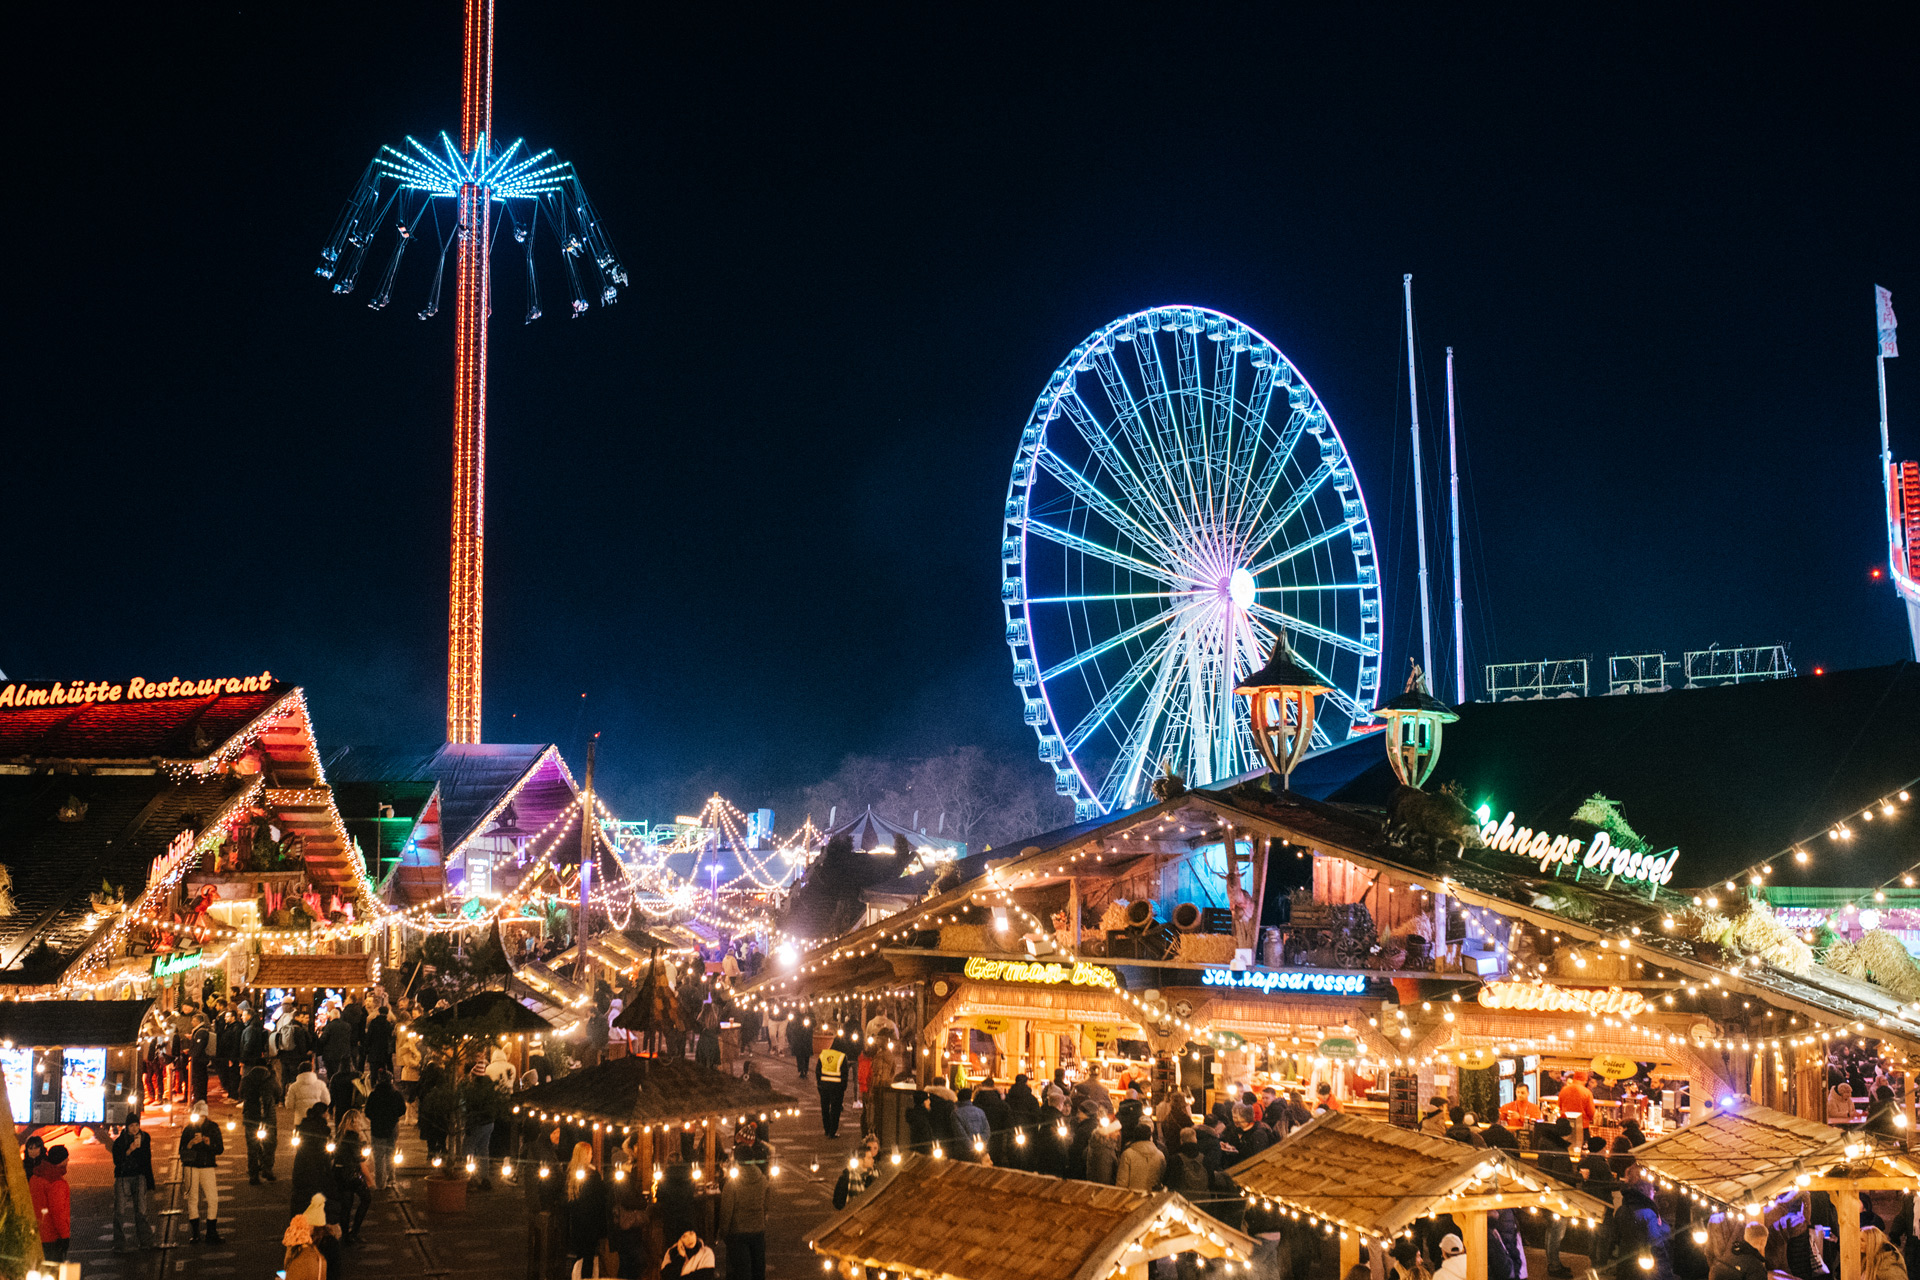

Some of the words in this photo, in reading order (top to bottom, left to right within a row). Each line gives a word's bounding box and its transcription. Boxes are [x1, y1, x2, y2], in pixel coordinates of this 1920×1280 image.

[0, 680, 123, 707] Almhütte
[127, 670, 272, 700] Restaurant
[1583, 831, 1680, 886] Drossel
[964, 957, 1063, 985] German
[1603, 1060, 1626, 1068] Collect
[1606, 1067, 1621, 1075] Here
